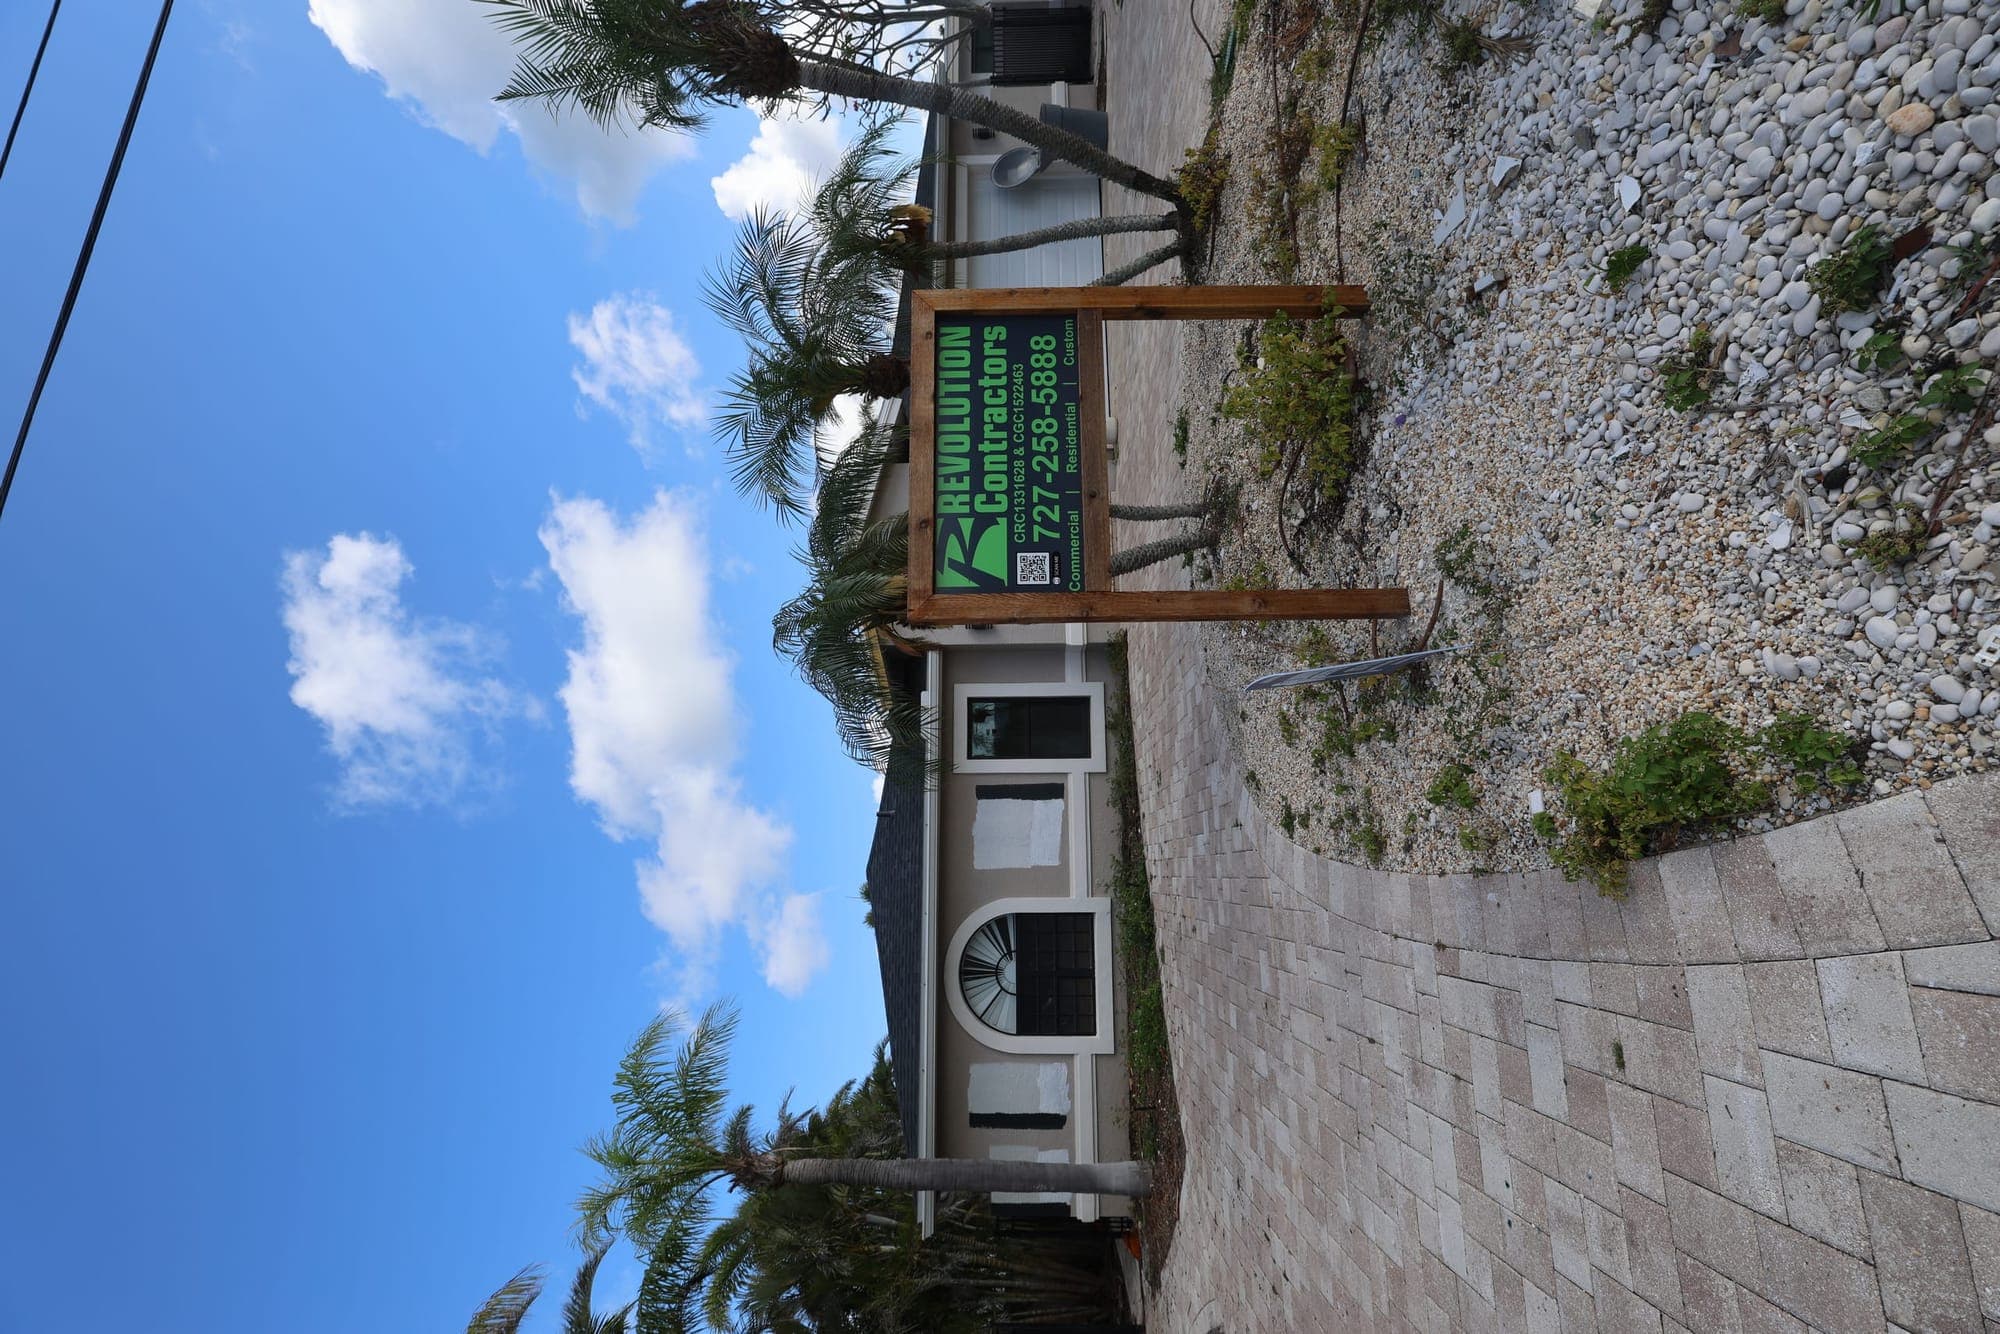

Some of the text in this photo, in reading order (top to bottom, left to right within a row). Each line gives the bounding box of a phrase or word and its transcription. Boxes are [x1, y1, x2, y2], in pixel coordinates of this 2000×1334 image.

[938, 325, 971, 514] REVOLUTION
[974, 325, 1008, 513] Contractors
[1013, 363, 1025, 543] CRC1331628 & CGC1522463
[1030, 334, 1060, 542] 727-258-5888
[1063, 319, 1081, 592] Commercial Residential Custom
